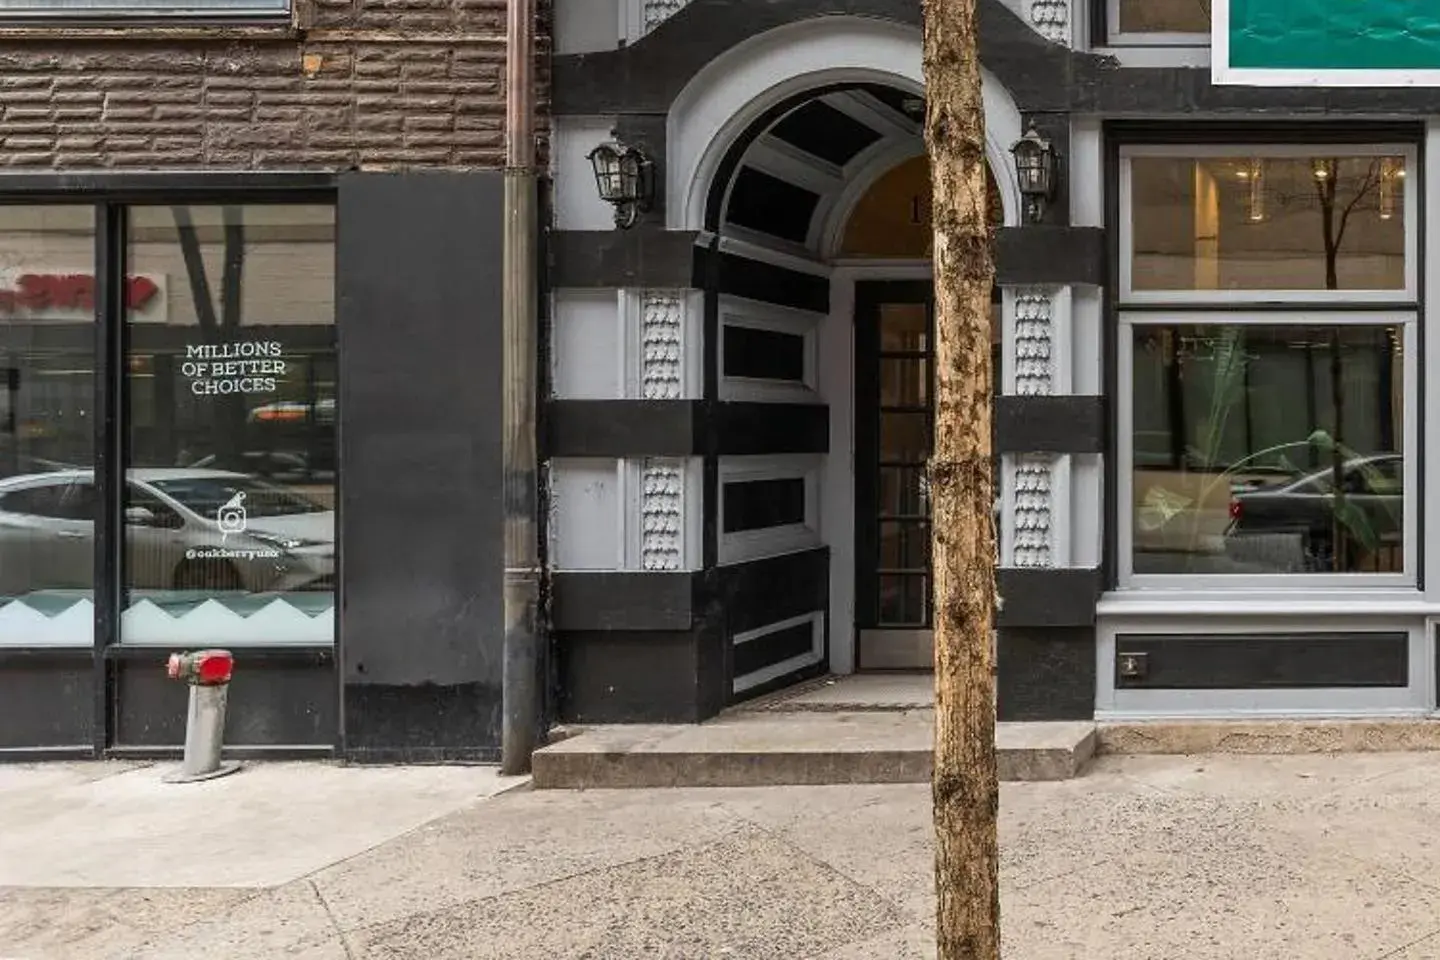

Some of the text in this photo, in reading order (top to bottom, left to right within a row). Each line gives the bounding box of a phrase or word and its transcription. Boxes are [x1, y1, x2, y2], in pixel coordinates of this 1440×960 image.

[186, 341, 281, 358] MILLIONS
[181, 360, 286, 377] OF BETTER
[191, 378, 276, 395] CHOICES
